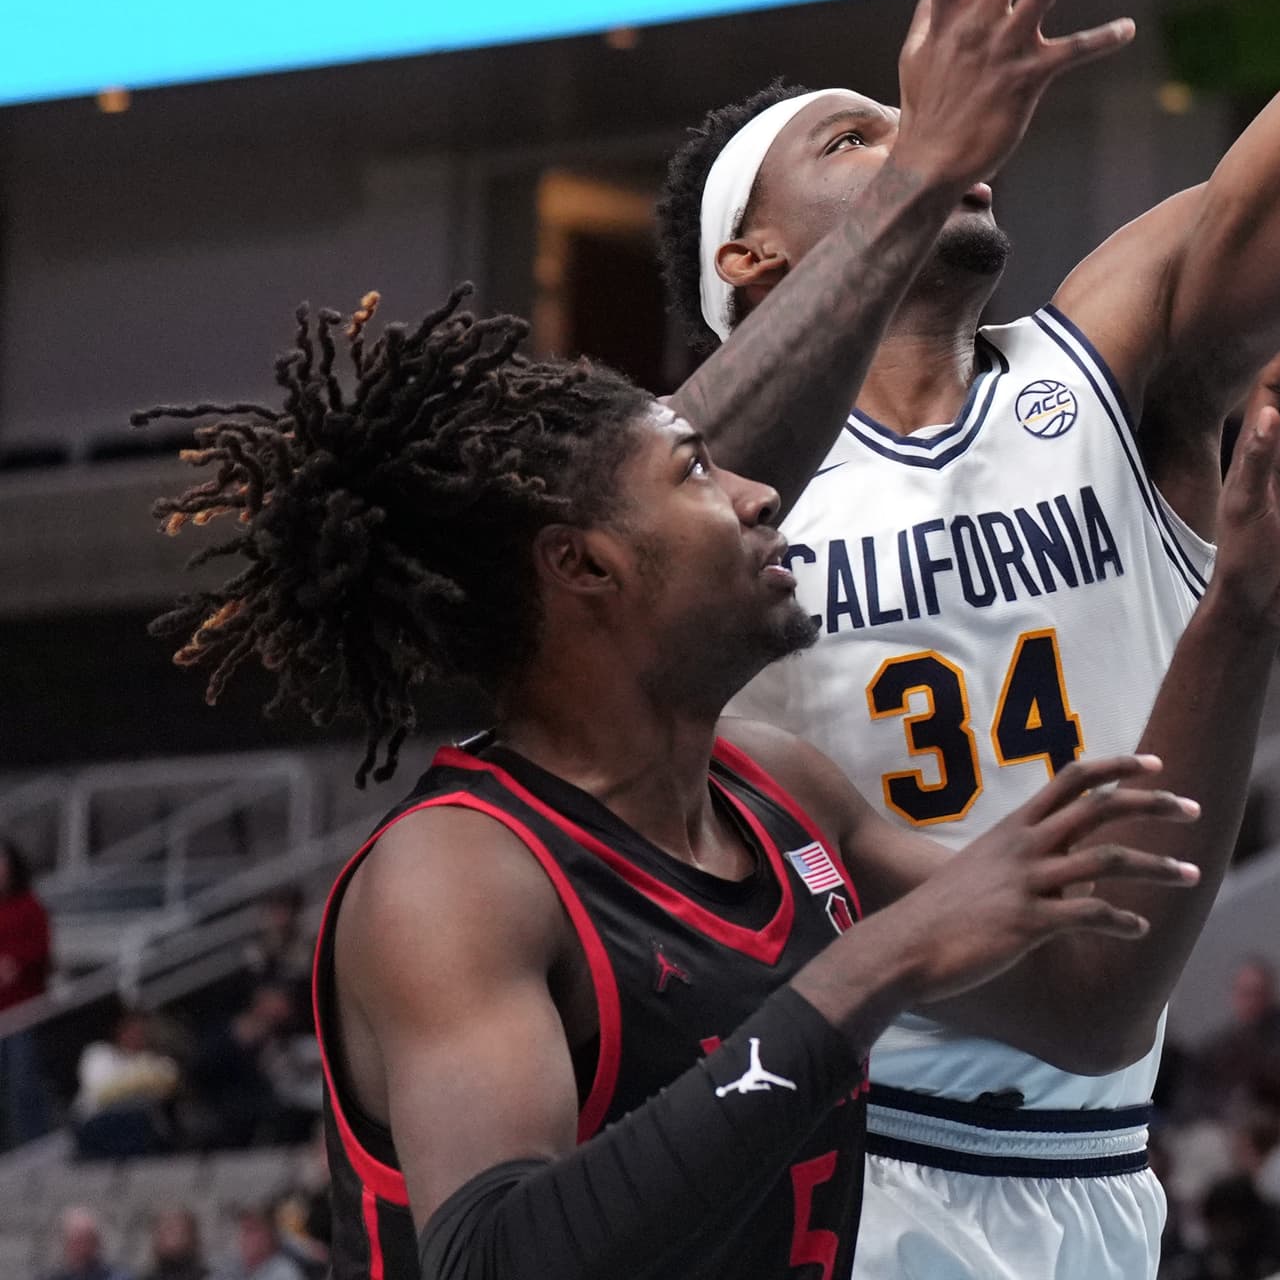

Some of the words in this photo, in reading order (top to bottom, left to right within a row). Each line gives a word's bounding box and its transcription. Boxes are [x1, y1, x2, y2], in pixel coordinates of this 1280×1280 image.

[1025, 388, 1071, 420] ACC
[866, 627, 1086, 827] 34
[788, 1150, 839, 1280] 5
